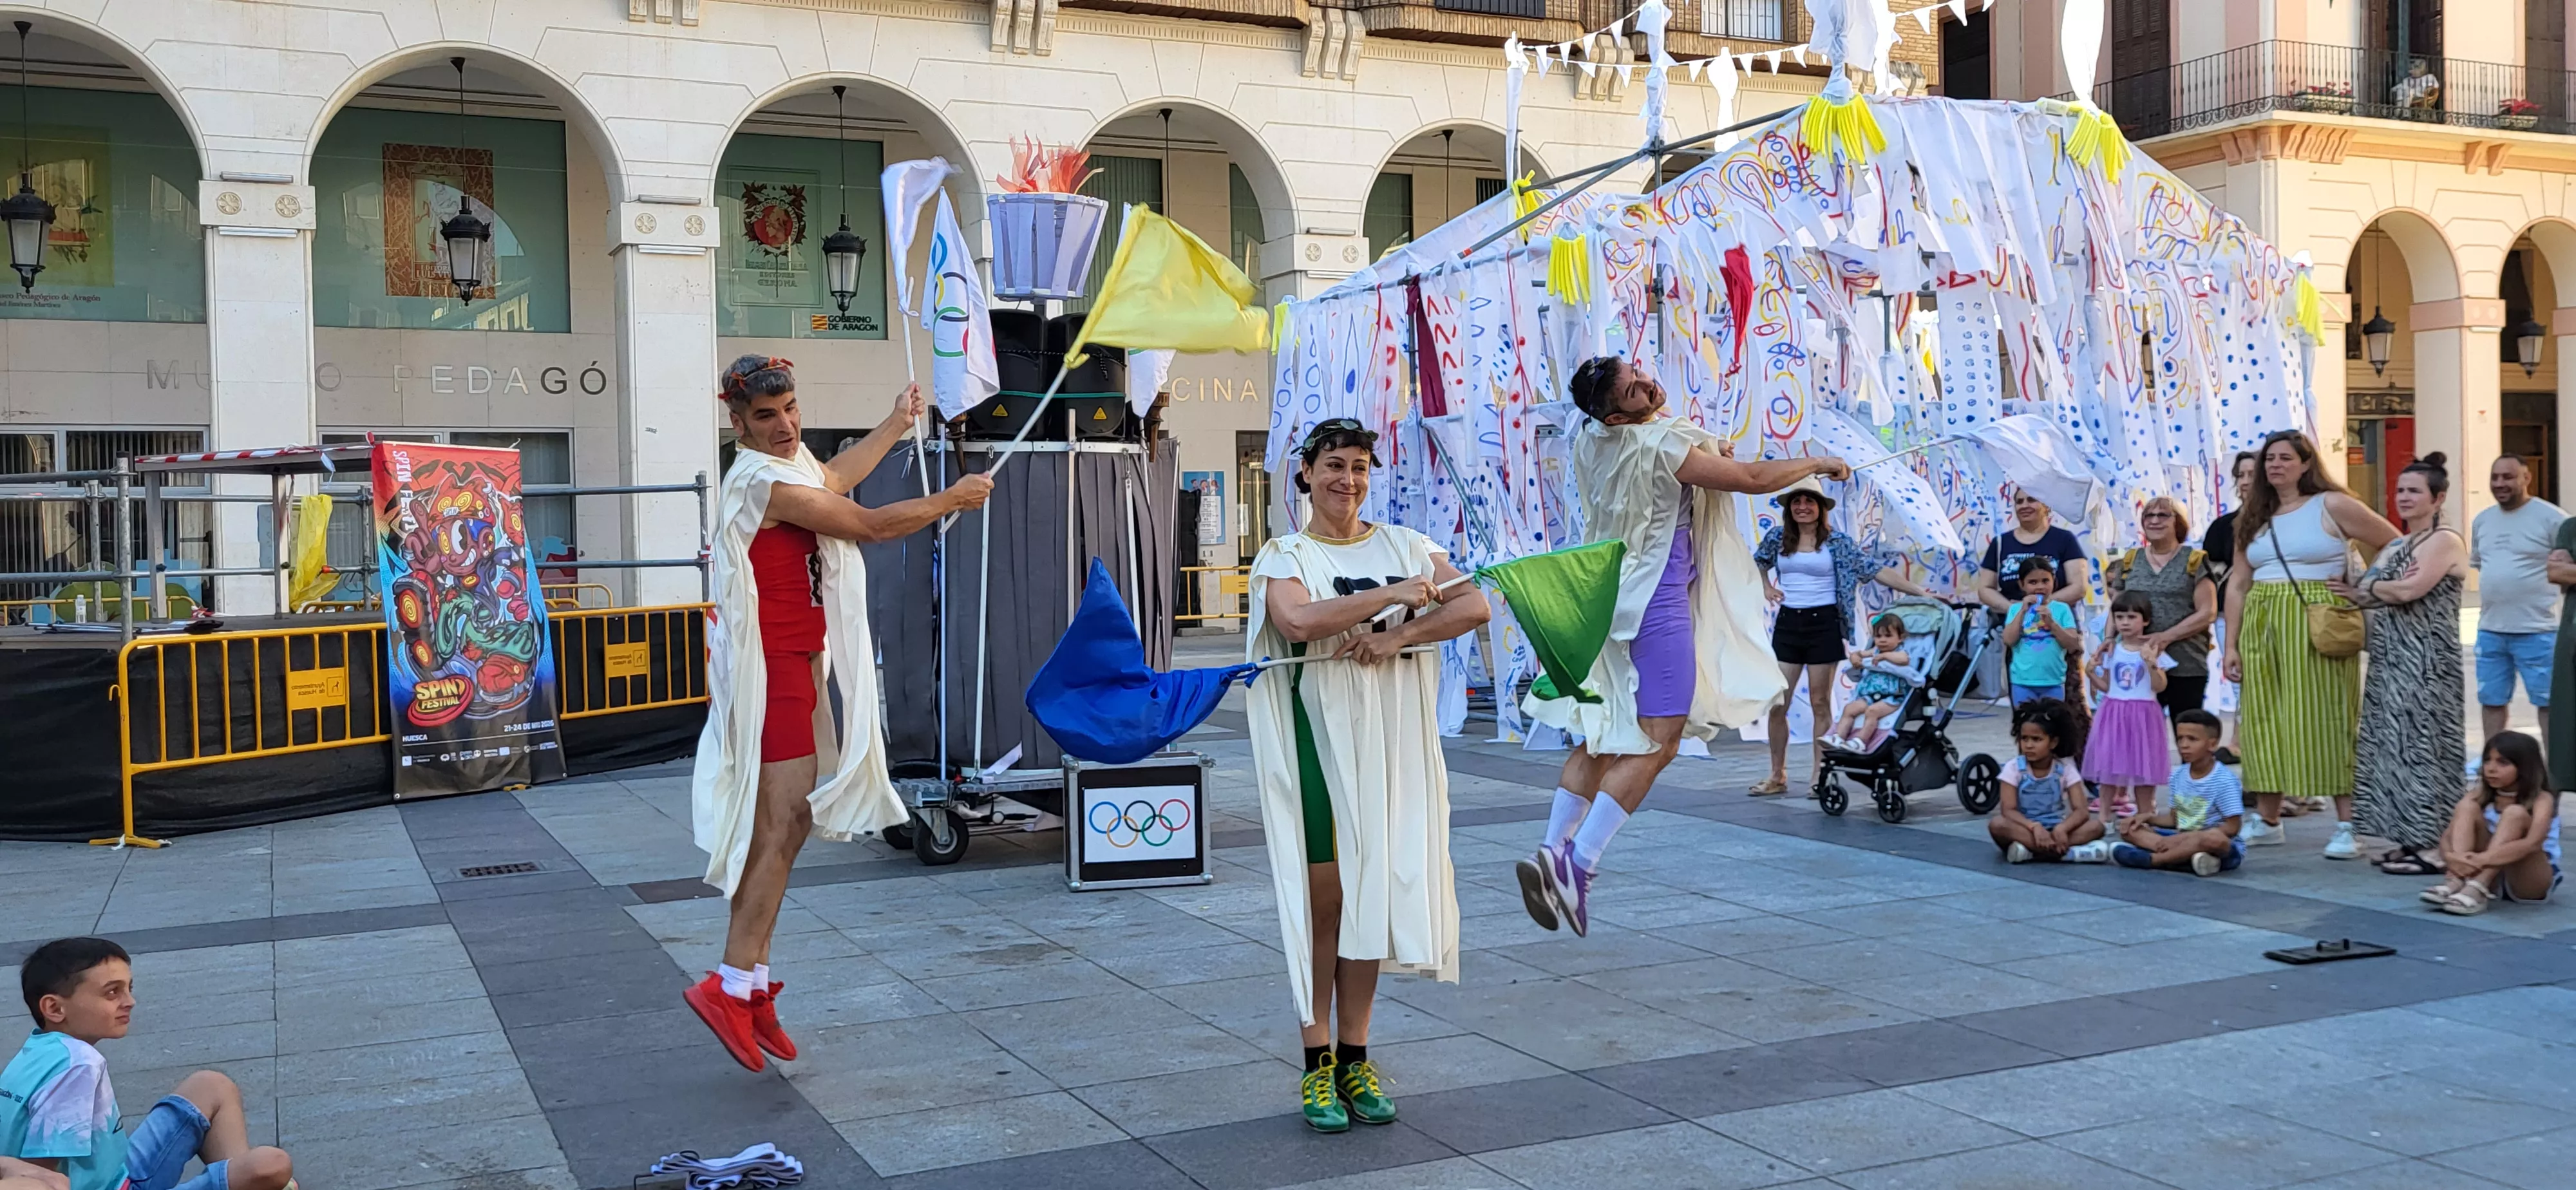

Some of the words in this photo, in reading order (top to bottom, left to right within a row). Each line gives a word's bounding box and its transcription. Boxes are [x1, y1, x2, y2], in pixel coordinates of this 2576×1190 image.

[417, 269, 437, 278] LUIS
[16, 292, 59, 301] Pedagógico
[73, 294, 100, 303] Aragón
[828, 315, 872, 323] GOBIERNO
[393, 451, 412, 483] SPIN
[415, 679, 459, 700] SPIN
[422, 696, 460, 710] FESTIVAL
[504, 723, 522, 732] 21-24
